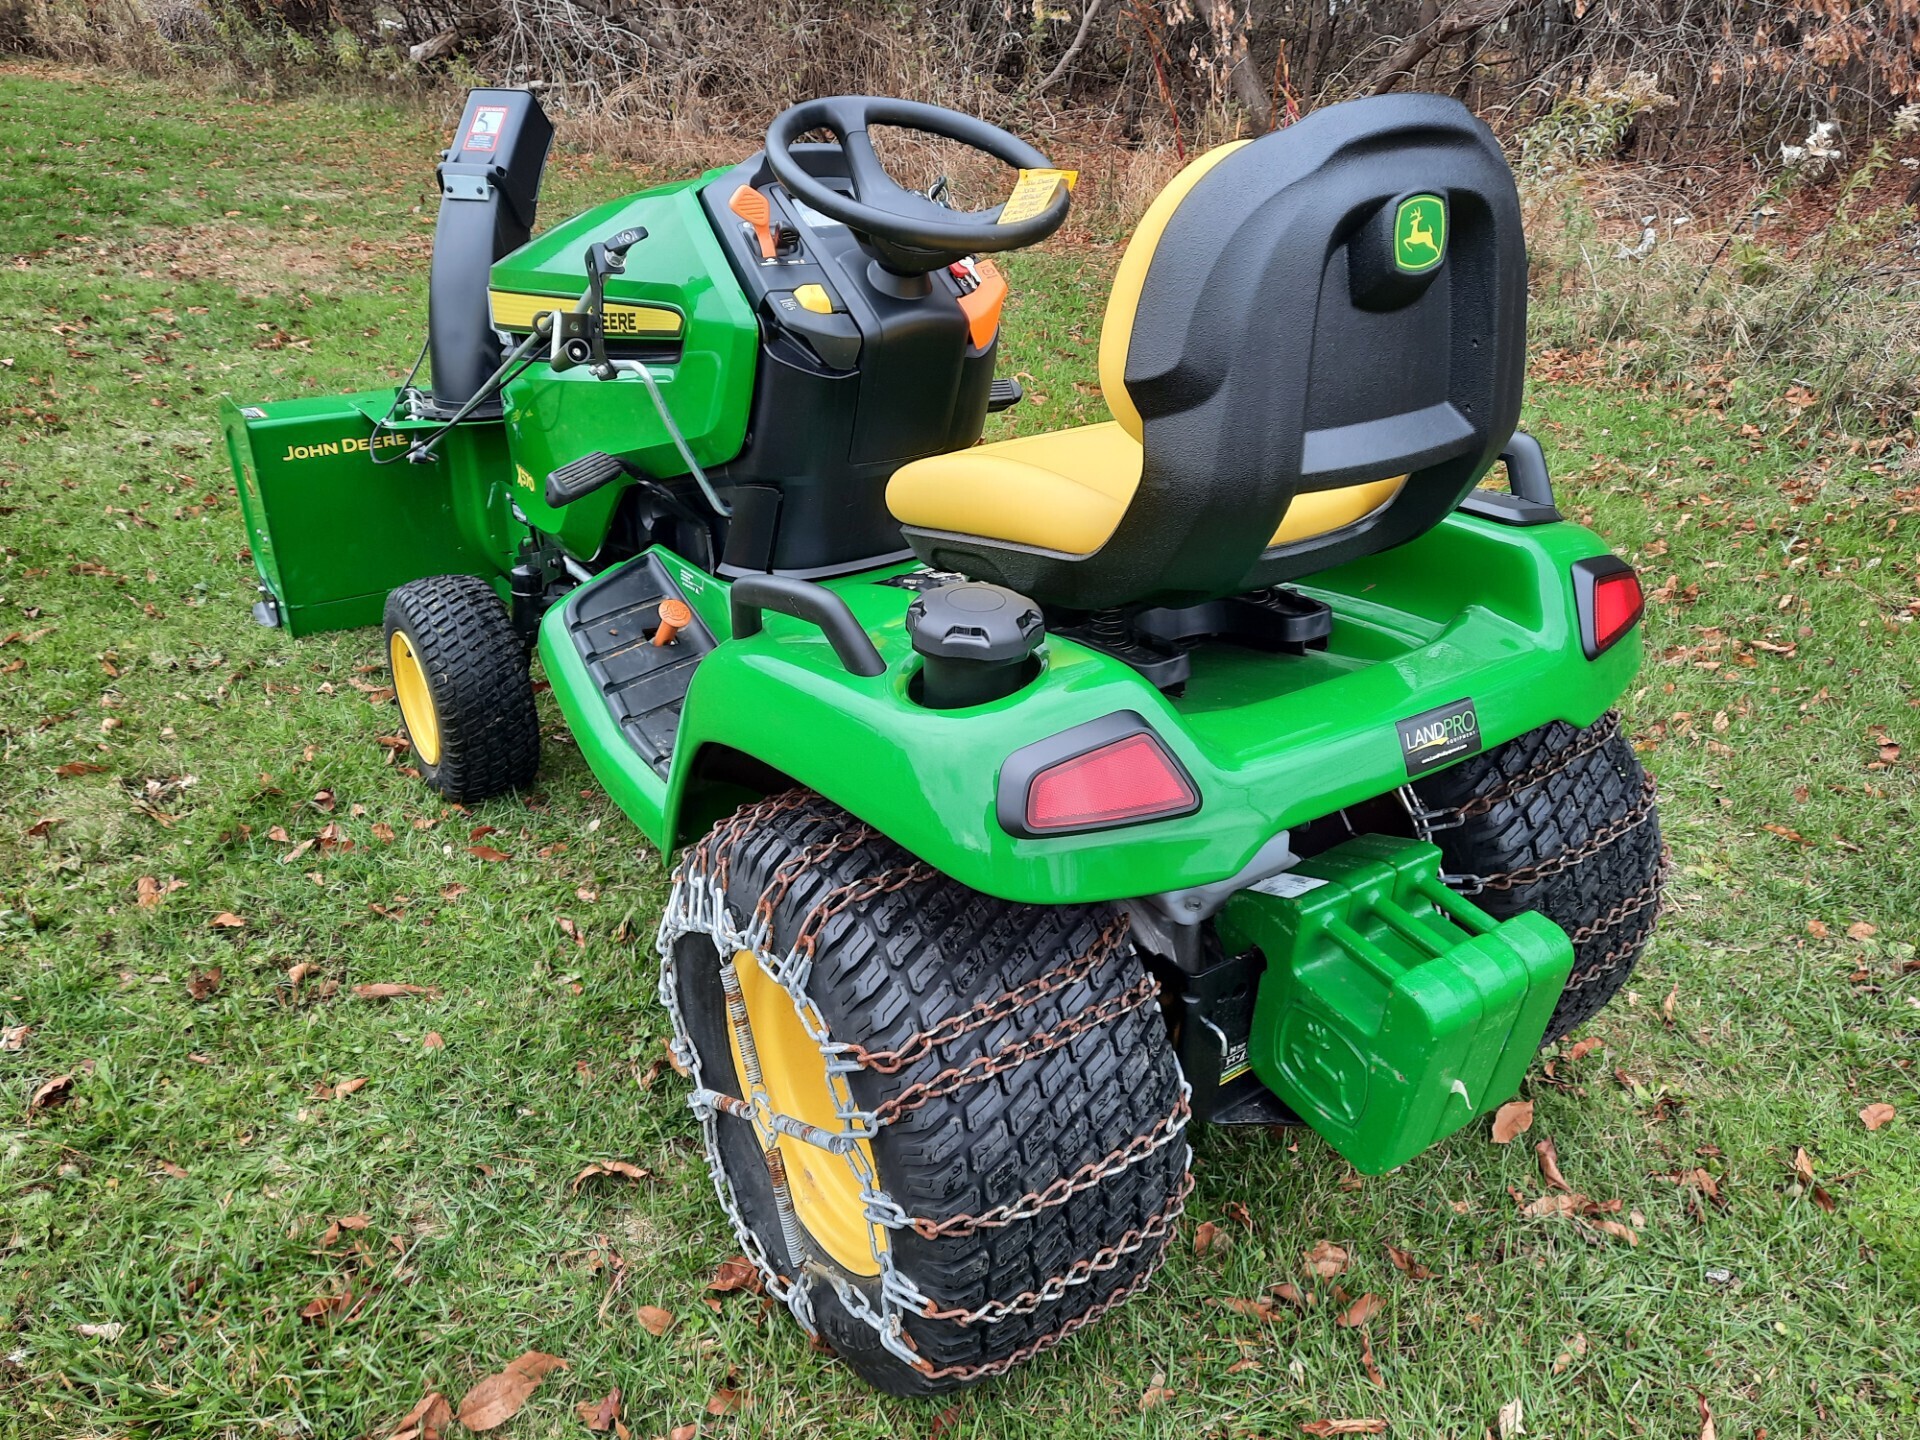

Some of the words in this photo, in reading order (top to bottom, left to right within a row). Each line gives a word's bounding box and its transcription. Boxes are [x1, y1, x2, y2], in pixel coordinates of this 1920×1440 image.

[602, 312, 637, 334] EERE
[282, 442, 339, 462] JOHN
[341, 433, 409, 453] DEERE
[1405, 710, 1476, 750] LANDPRO
